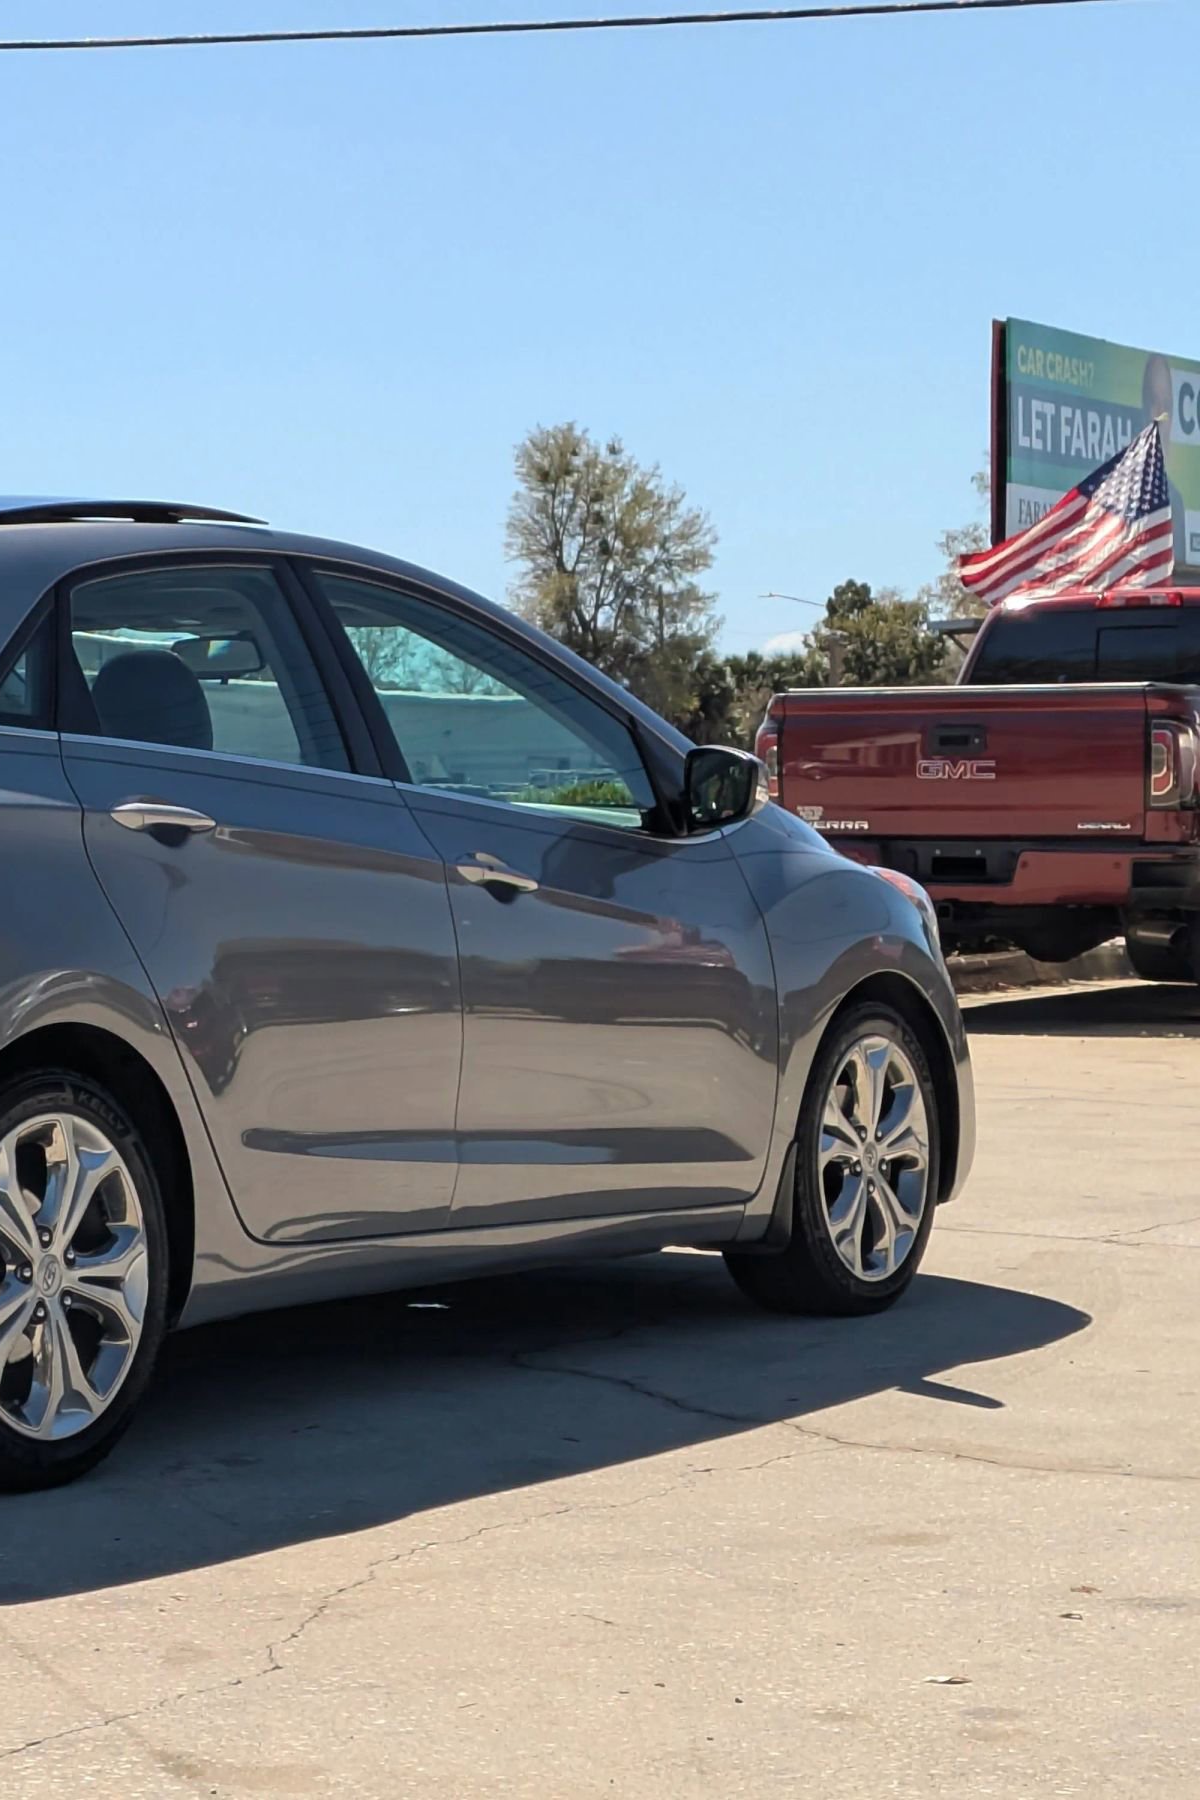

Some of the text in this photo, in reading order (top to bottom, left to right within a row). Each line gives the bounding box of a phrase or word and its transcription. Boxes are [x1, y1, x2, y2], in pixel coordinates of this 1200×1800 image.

[1017, 344, 1095, 388] CAR CRASH?
[1017, 396, 1132, 461] LET FARAH
[1178, 381, 1200, 435] C
[1018, 498, 1052, 525] FAR
[916, 759, 996, 779] GMC
